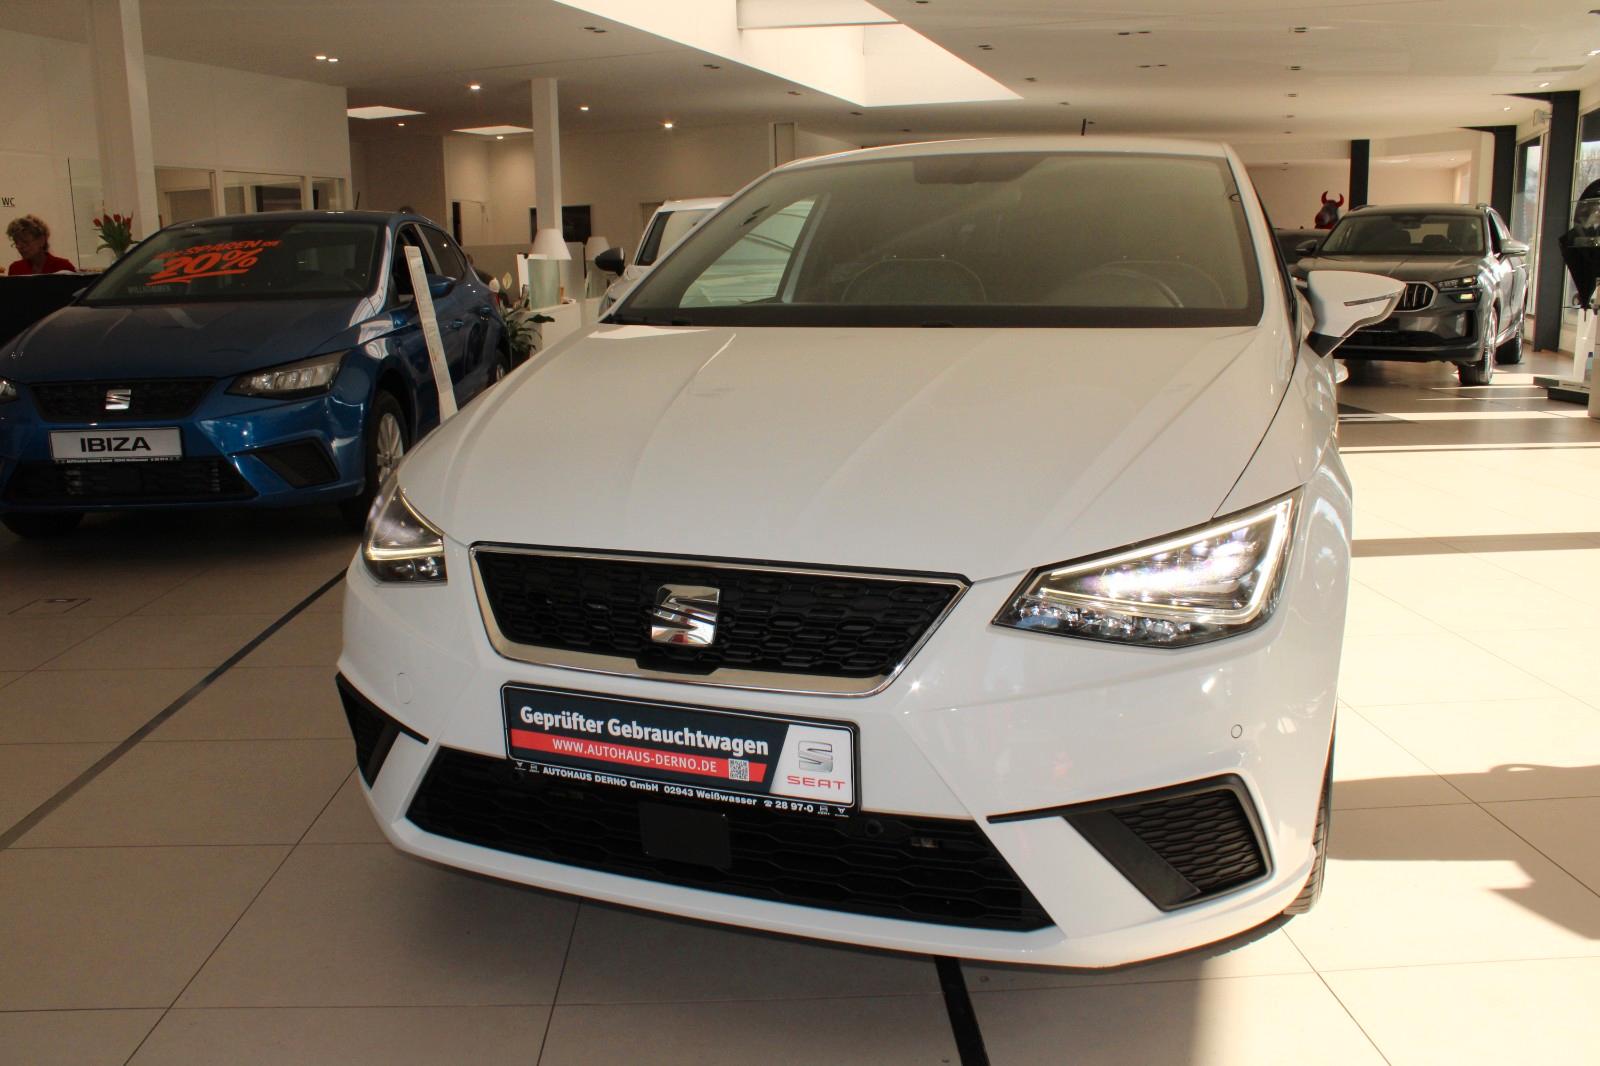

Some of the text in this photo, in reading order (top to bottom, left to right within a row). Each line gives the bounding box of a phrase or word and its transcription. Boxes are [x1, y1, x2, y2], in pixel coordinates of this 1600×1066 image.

[1, 196, 15, 207] WC
[150, 248, 264, 279] 20%
[80, 437, 151, 452] IBIZA
[520, 706, 769, 757] Geprüfter Gebrauchtwagen
[552, 738, 718, 773] WWW.AUTOHAUS-DERNO.DE
[542, 766, 592, 782] AUTOHAUS
[594, 774, 627, 787] DERNO
[629, 780, 659, 792] GmbH
[663, 785, 694, 797] 02943
[696, 789, 757, 805] Weißwasser
[775, 800, 788, 810] 28
[786, 775, 846, 790] SEAT
